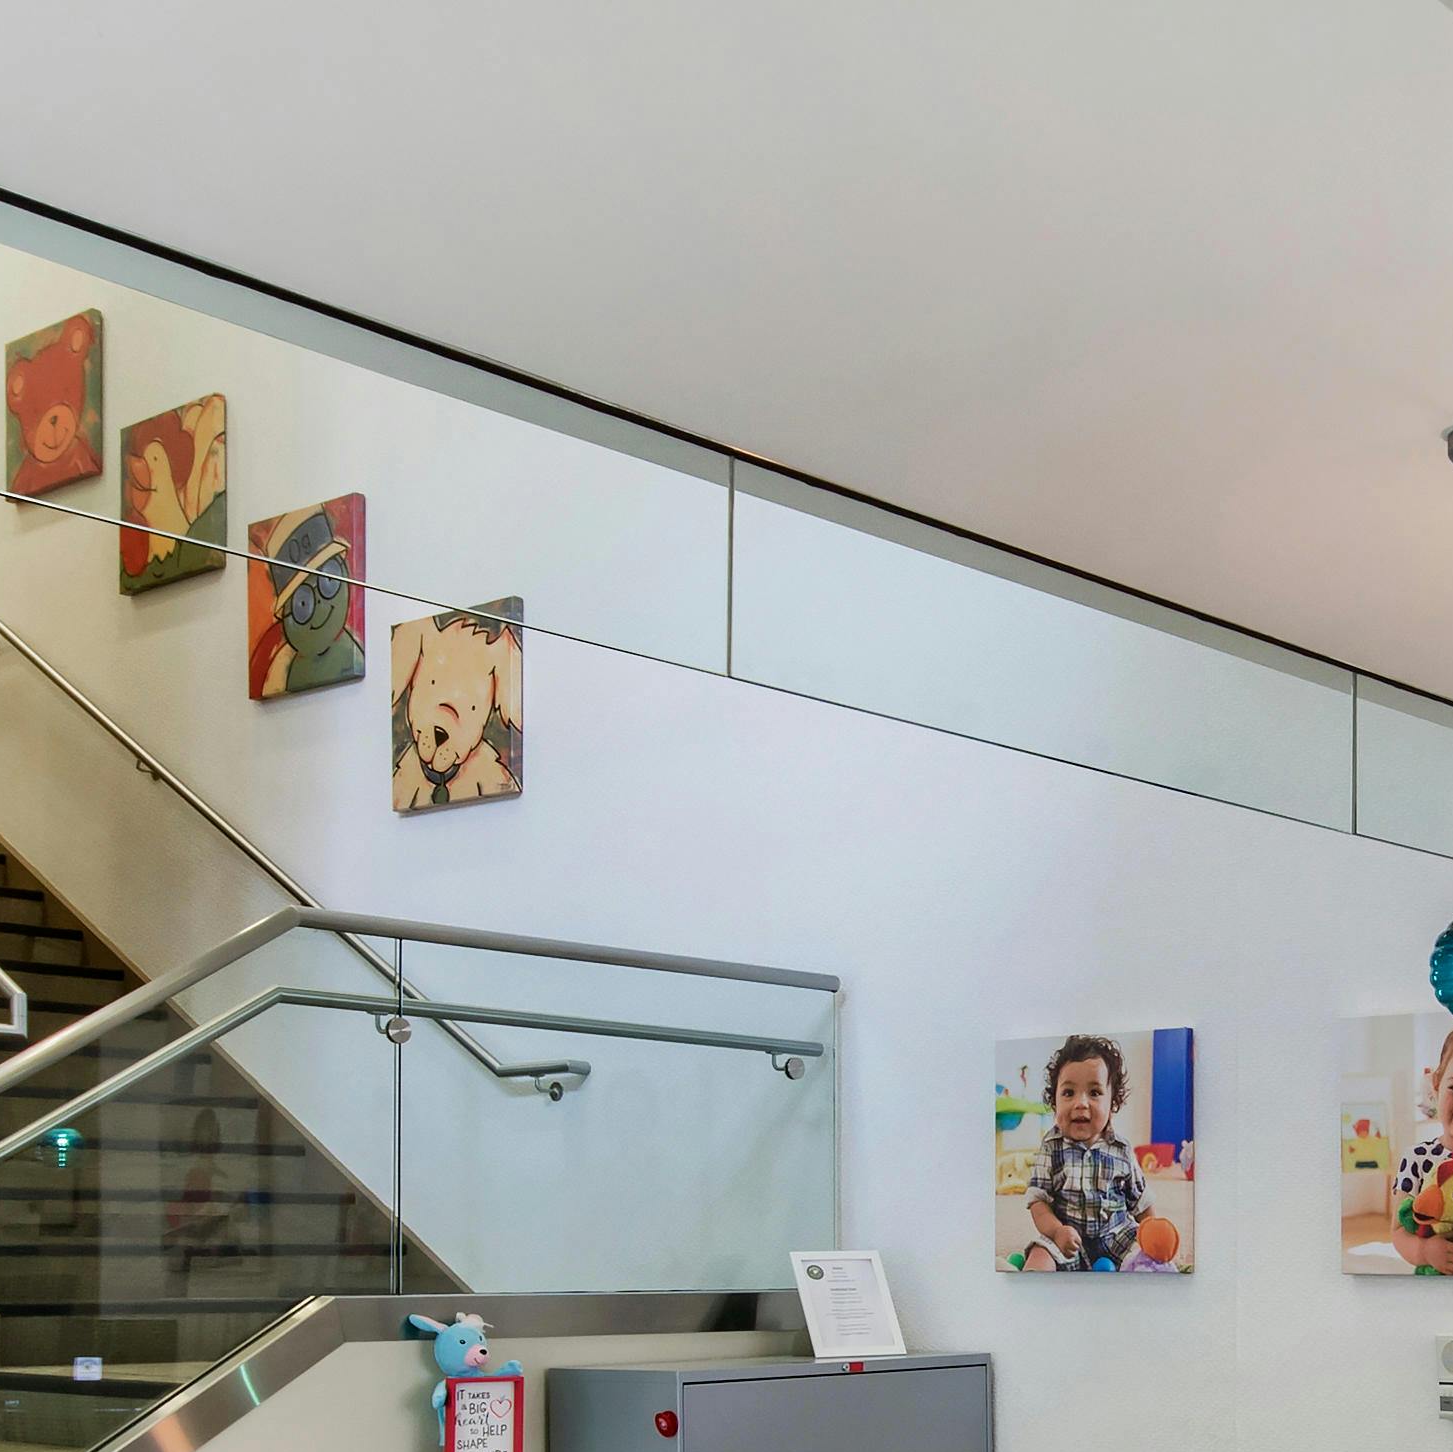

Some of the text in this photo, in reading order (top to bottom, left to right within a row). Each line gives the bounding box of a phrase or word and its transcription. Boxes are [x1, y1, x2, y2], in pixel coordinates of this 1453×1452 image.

[457, 1390, 491, 1400] IT TAKES
[469, 1402, 487, 1415] BIG
[482, 1424, 508, 1437] HELP
[457, 1438, 488, 1450] SHAPE
